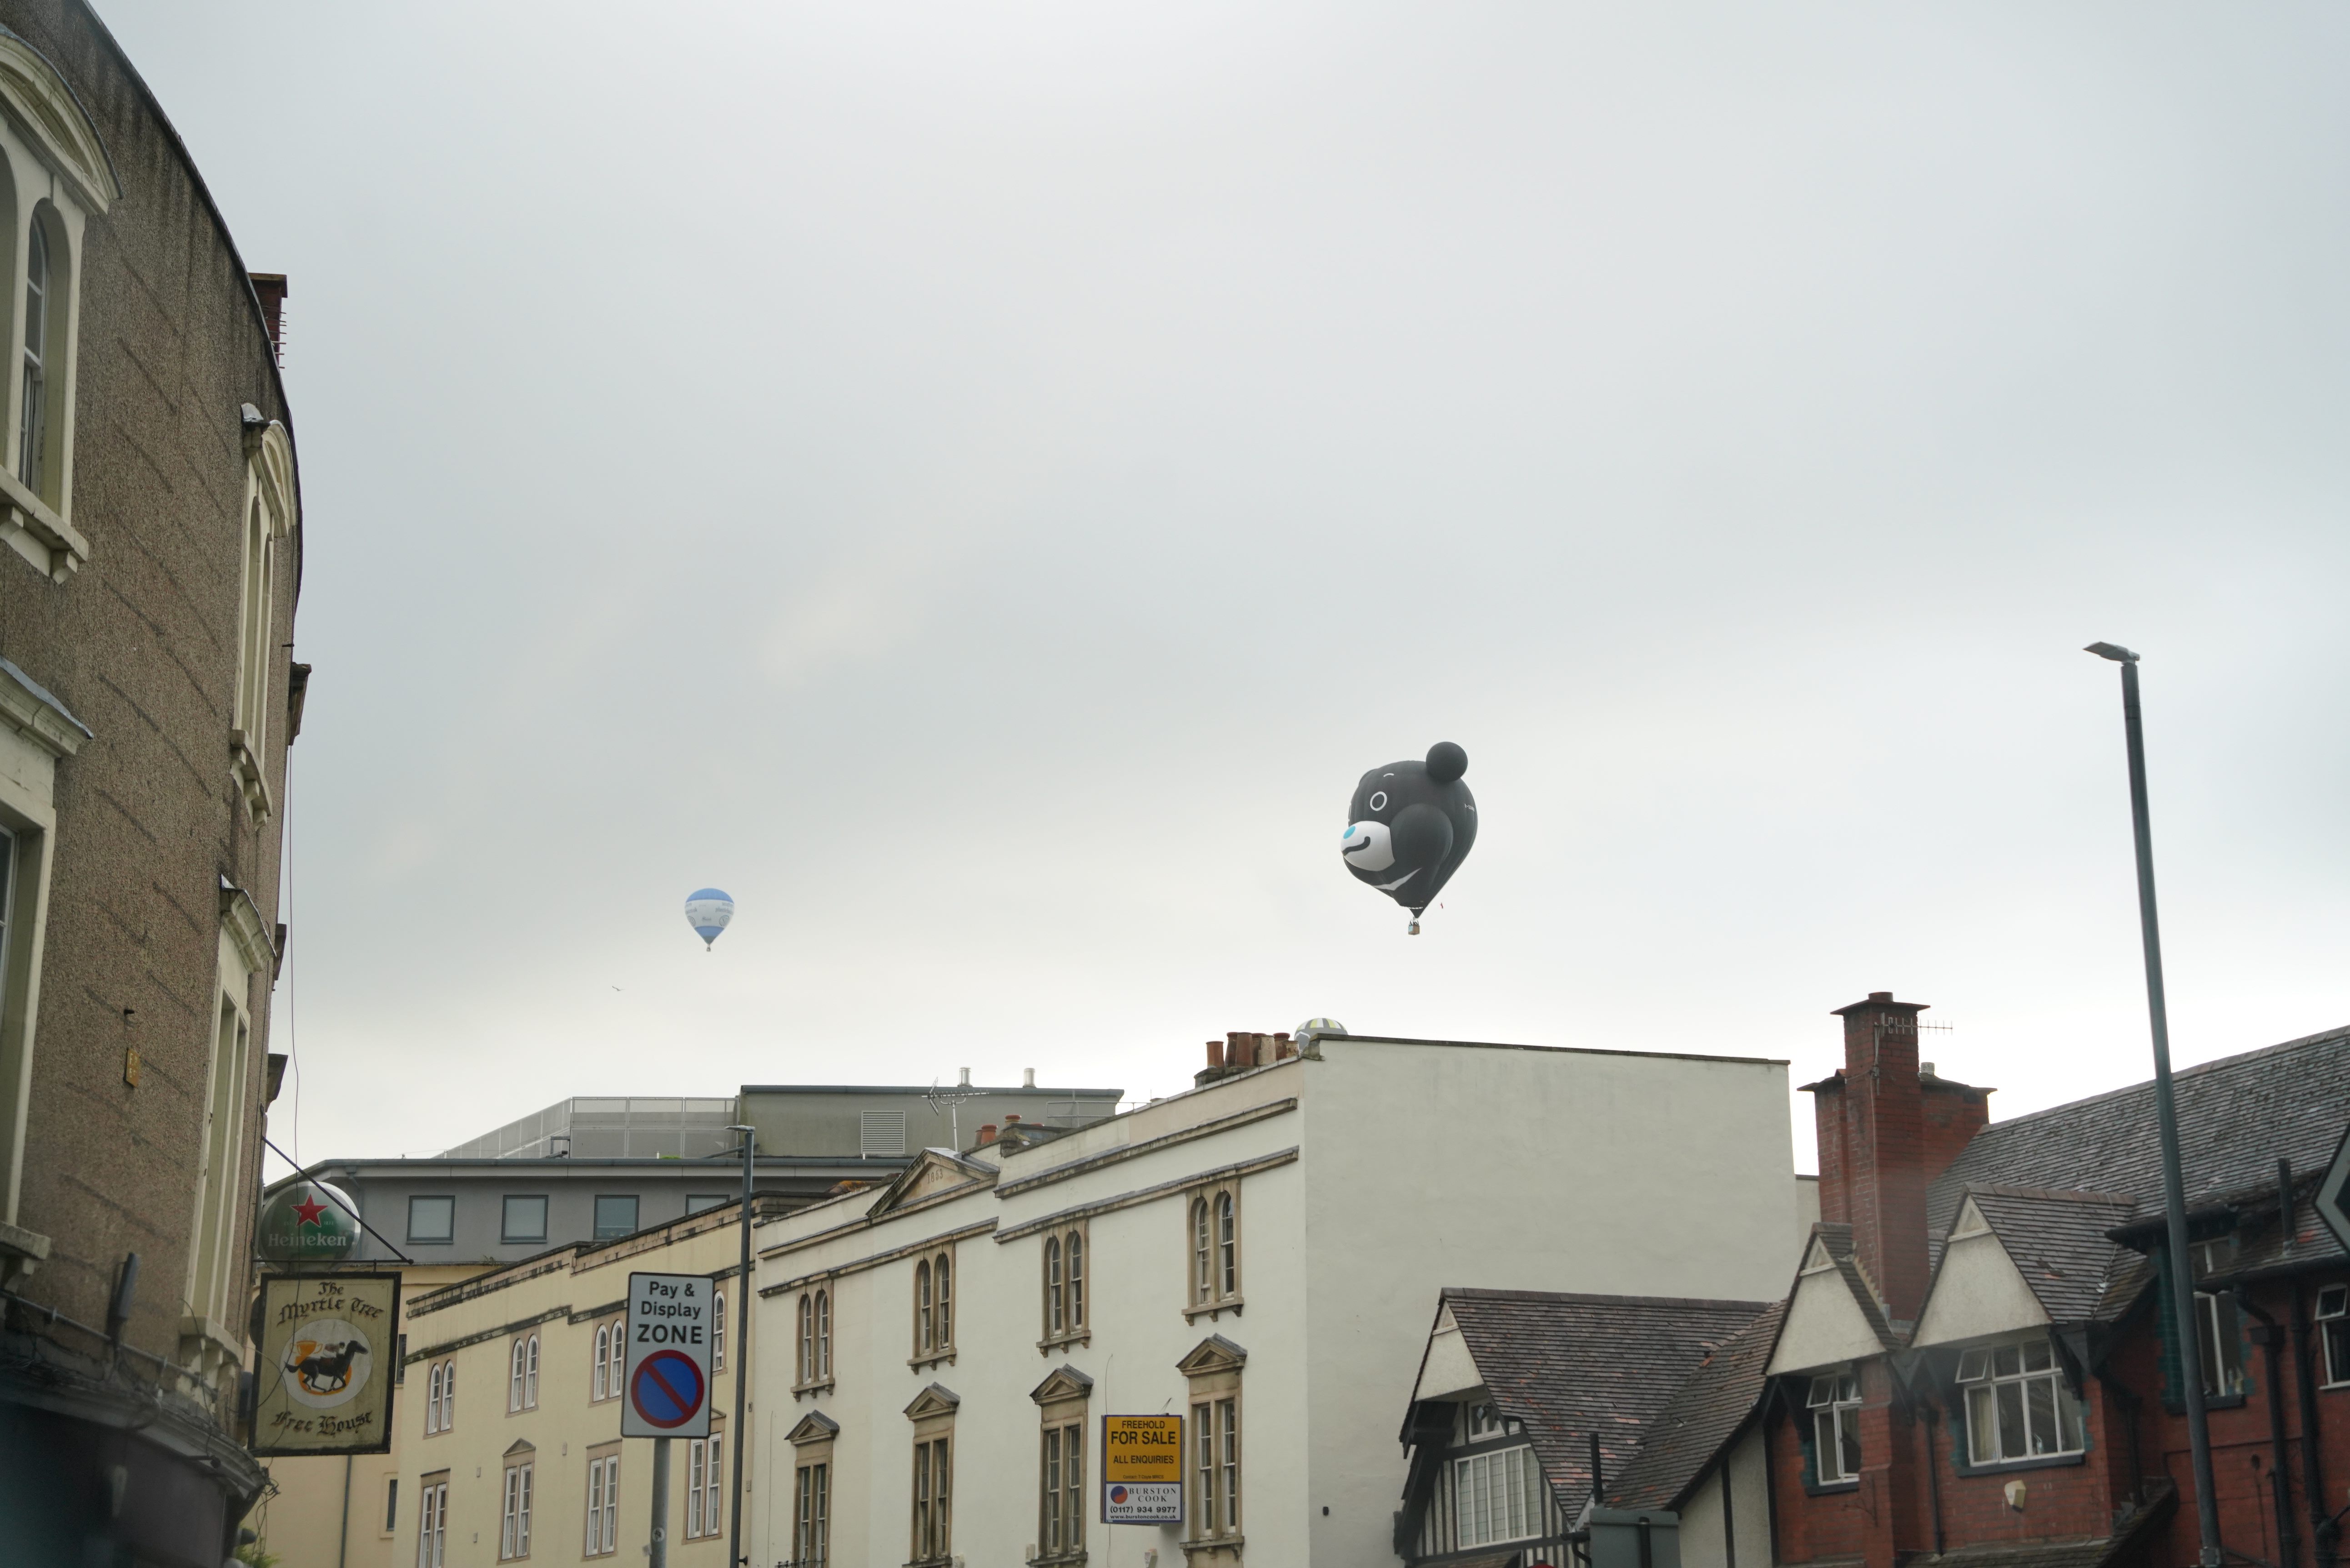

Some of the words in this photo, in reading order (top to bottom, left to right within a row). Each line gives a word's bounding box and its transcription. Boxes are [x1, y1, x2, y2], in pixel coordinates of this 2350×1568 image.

[268, 1233, 346, 1246] Heineken
[318, 1282, 344, 1295] The
[649, 1281, 678, 1299] Pay
[684, 1283, 695, 1297] &
[276, 1297, 346, 1327] Myrtle
[351, 1297, 384, 1318] Tree
[641, 1301, 701, 1320] Display
[637, 1324, 703, 1344] ZONE
[270, 1411, 313, 1432] Free
[317, 1411, 372, 1437] House
[1122, 1421, 1165, 1429] FREEHOLD
[1111, 1431, 1138, 1444] FOR
[1142, 1431, 1176, 1444] SALE
[1113, 1455, 1128, 1463] ALL
[1131, 1455, 1174, 1464] ENQUIRIES
